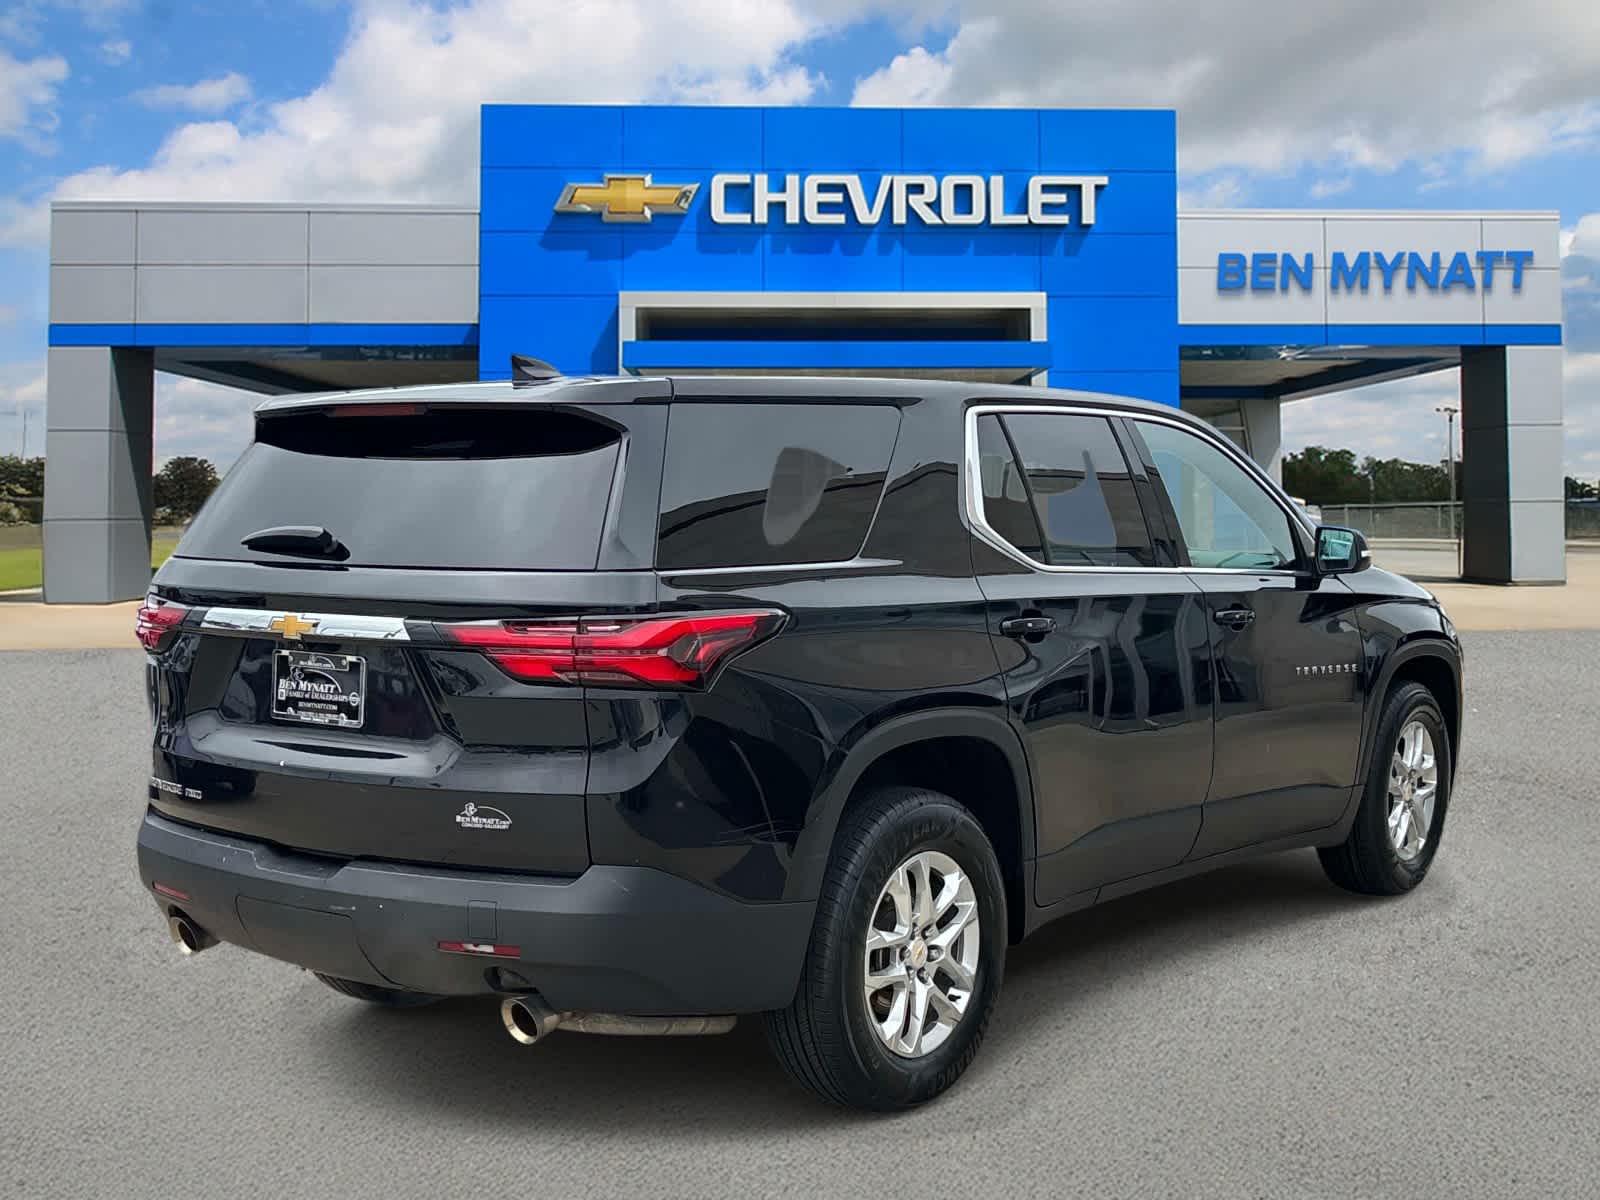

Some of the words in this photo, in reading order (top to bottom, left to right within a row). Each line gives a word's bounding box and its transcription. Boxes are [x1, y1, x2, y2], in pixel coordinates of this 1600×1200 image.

[710, 173, 1109, 226] CHEVROLET
[1217, 252, 1313, 291] BEN
[1330, 250, 1534, 290] MYNATT
[1295, 663, 1358, 677] TRAVERSE
[298, 680, 336, 693] MYNATT
